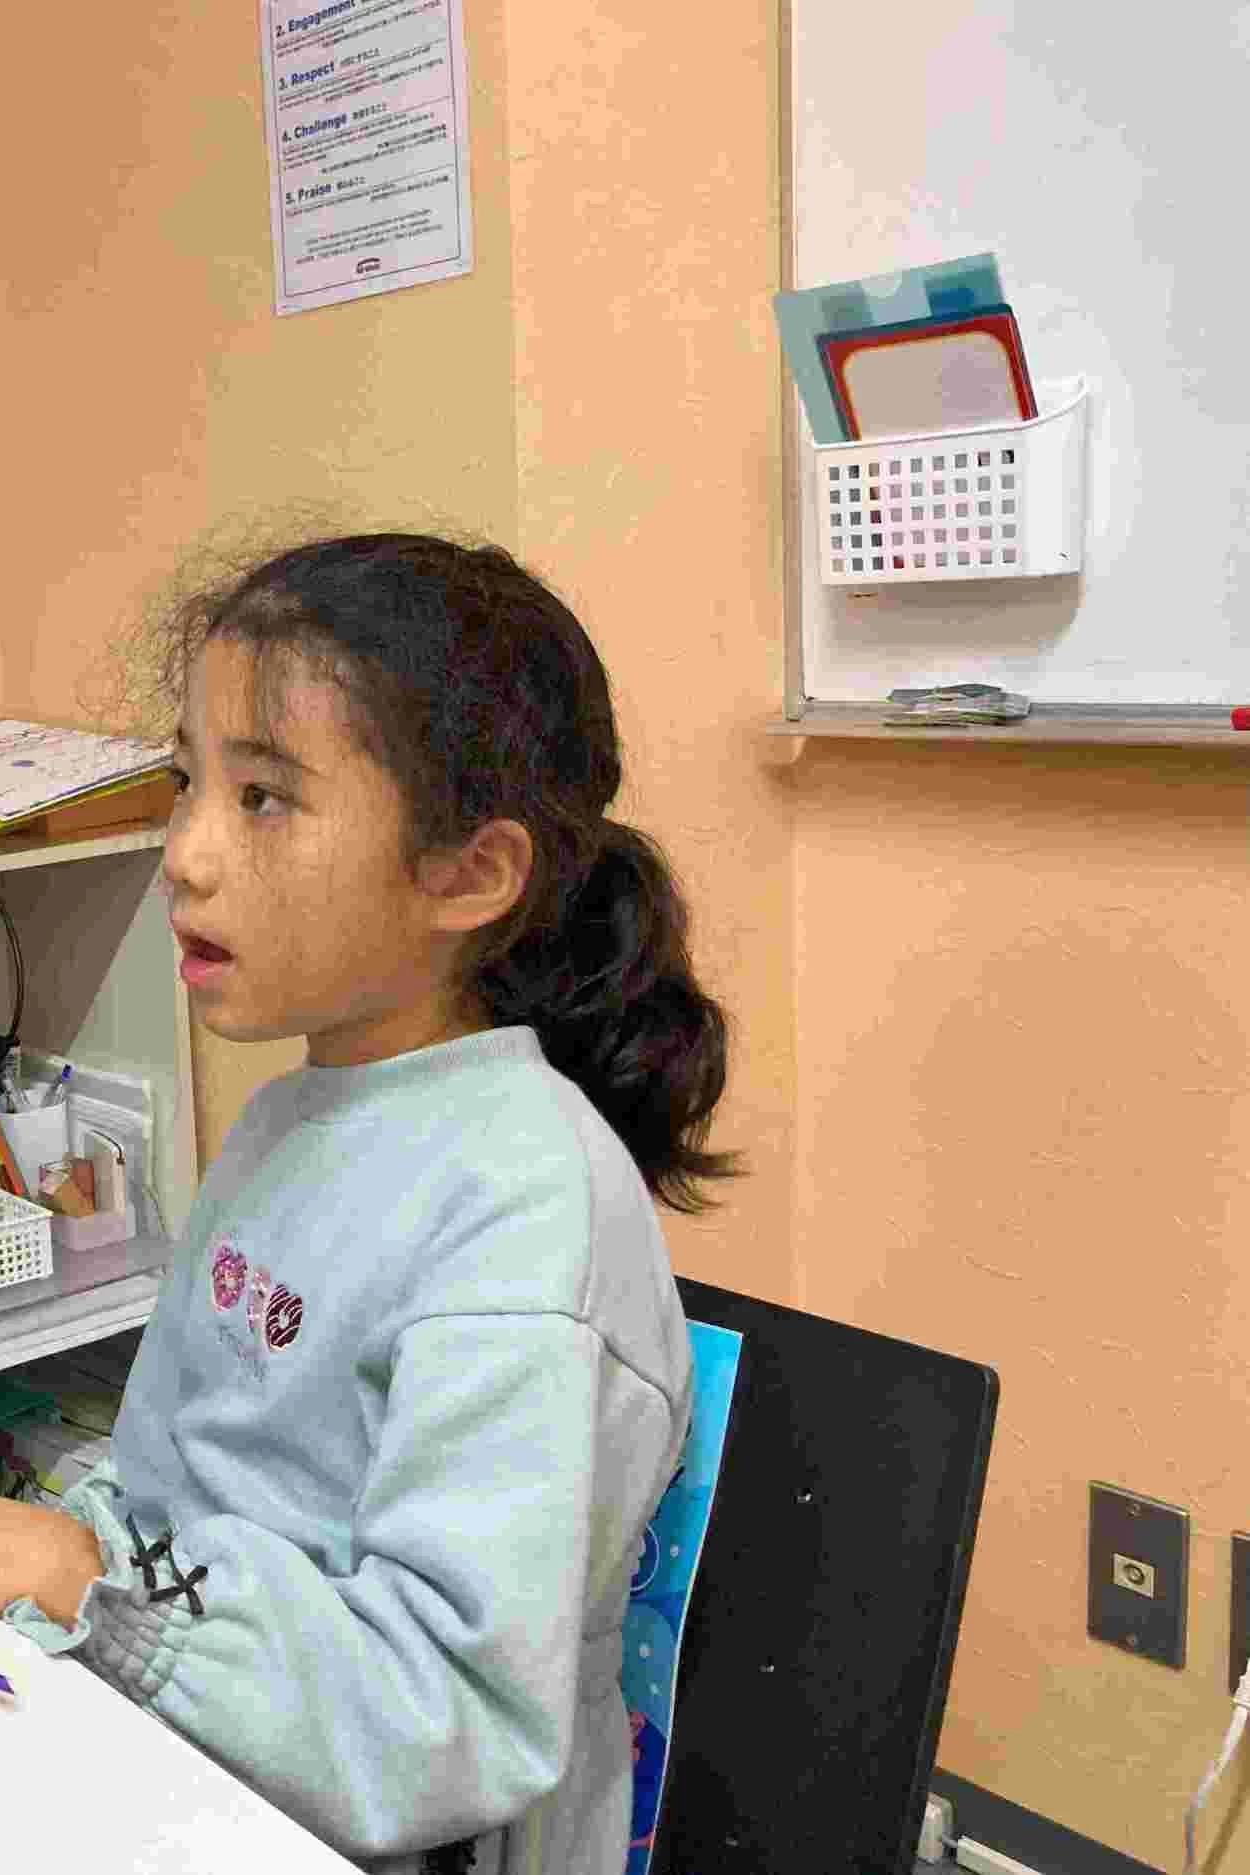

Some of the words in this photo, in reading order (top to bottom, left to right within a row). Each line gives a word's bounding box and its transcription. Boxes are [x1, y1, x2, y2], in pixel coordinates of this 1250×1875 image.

[291, 61, 334, 85] Respect
[294, 113, 347, 138] Challenge
[298, 184, 332, 202] Praise
